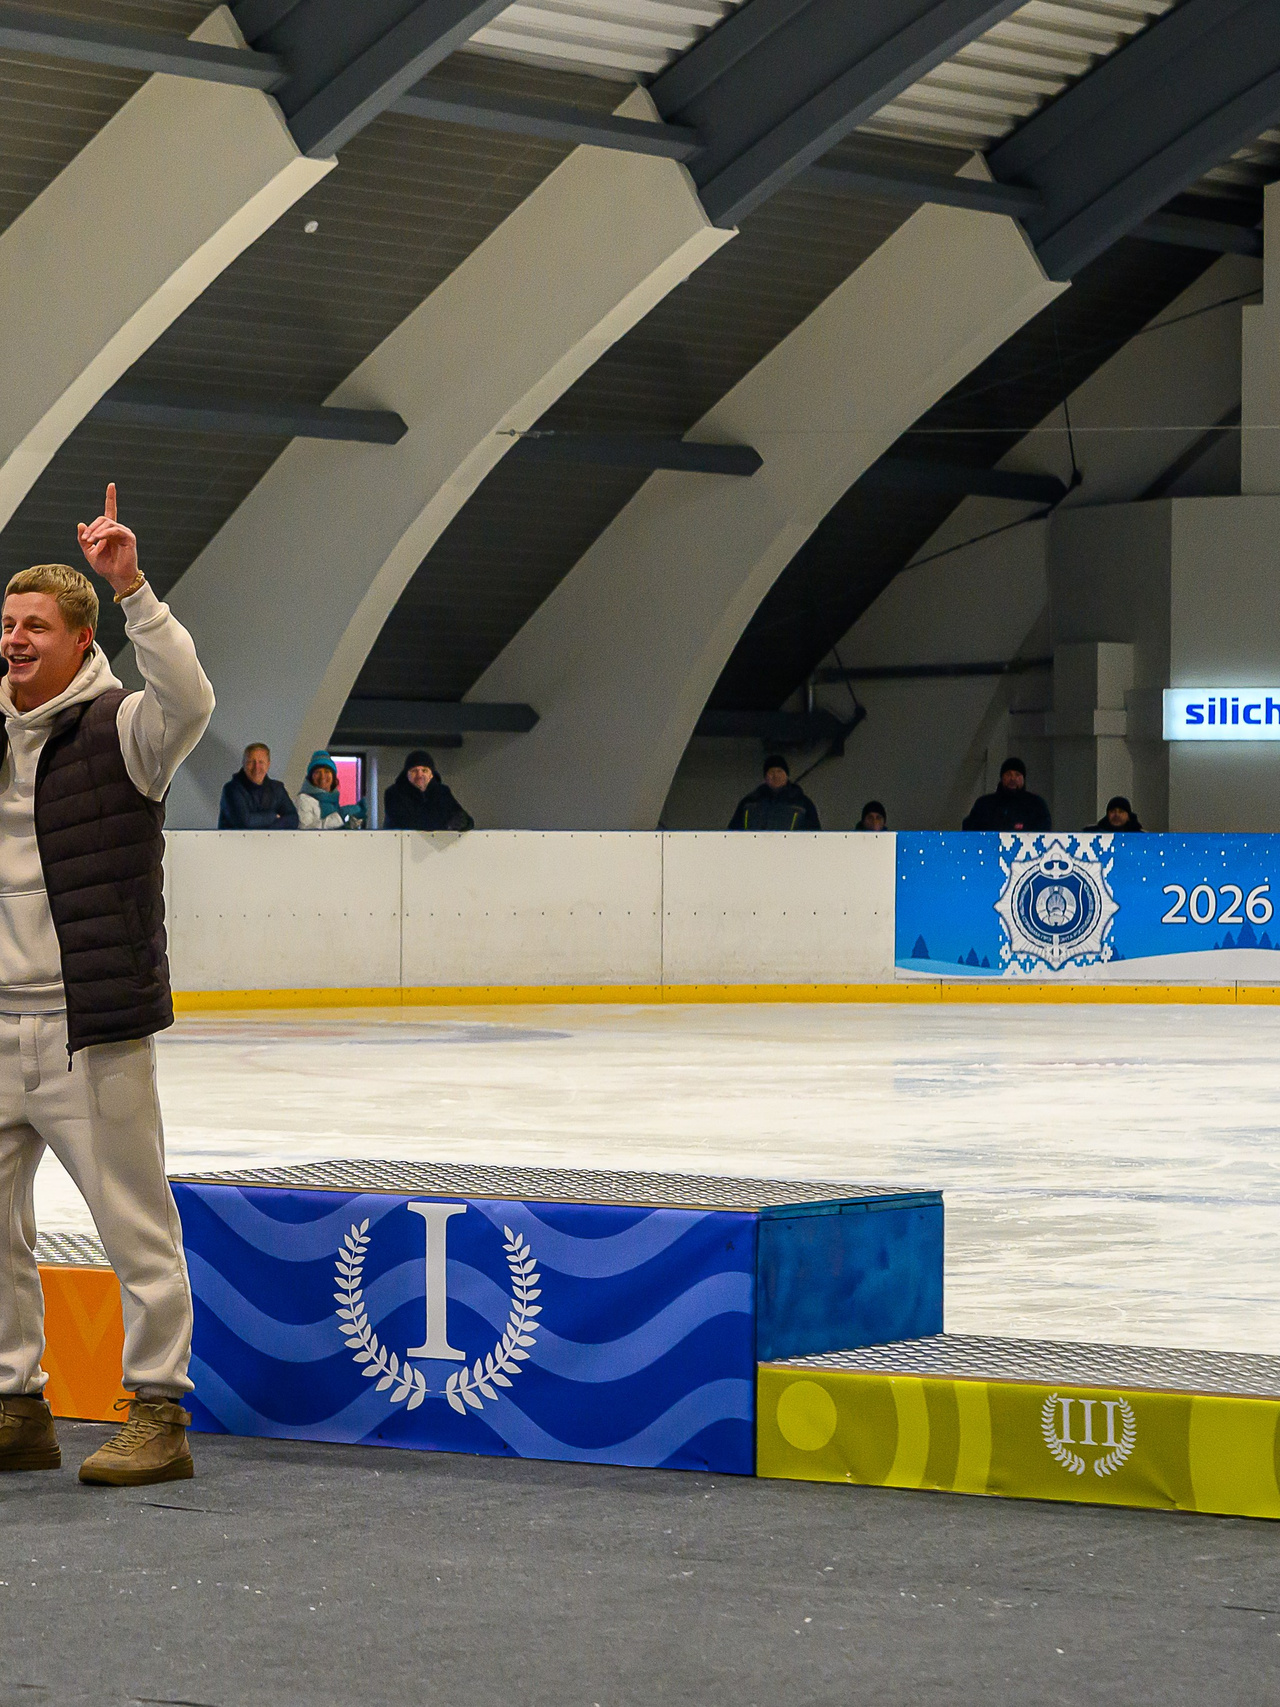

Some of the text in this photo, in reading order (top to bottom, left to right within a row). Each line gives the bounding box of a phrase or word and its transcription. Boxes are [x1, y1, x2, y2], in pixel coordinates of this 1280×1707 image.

[1161, 884, 1274, 924] 2026
[406, 1201, 468, 1361] I
[1056, 1397, 1121, 1448] III
